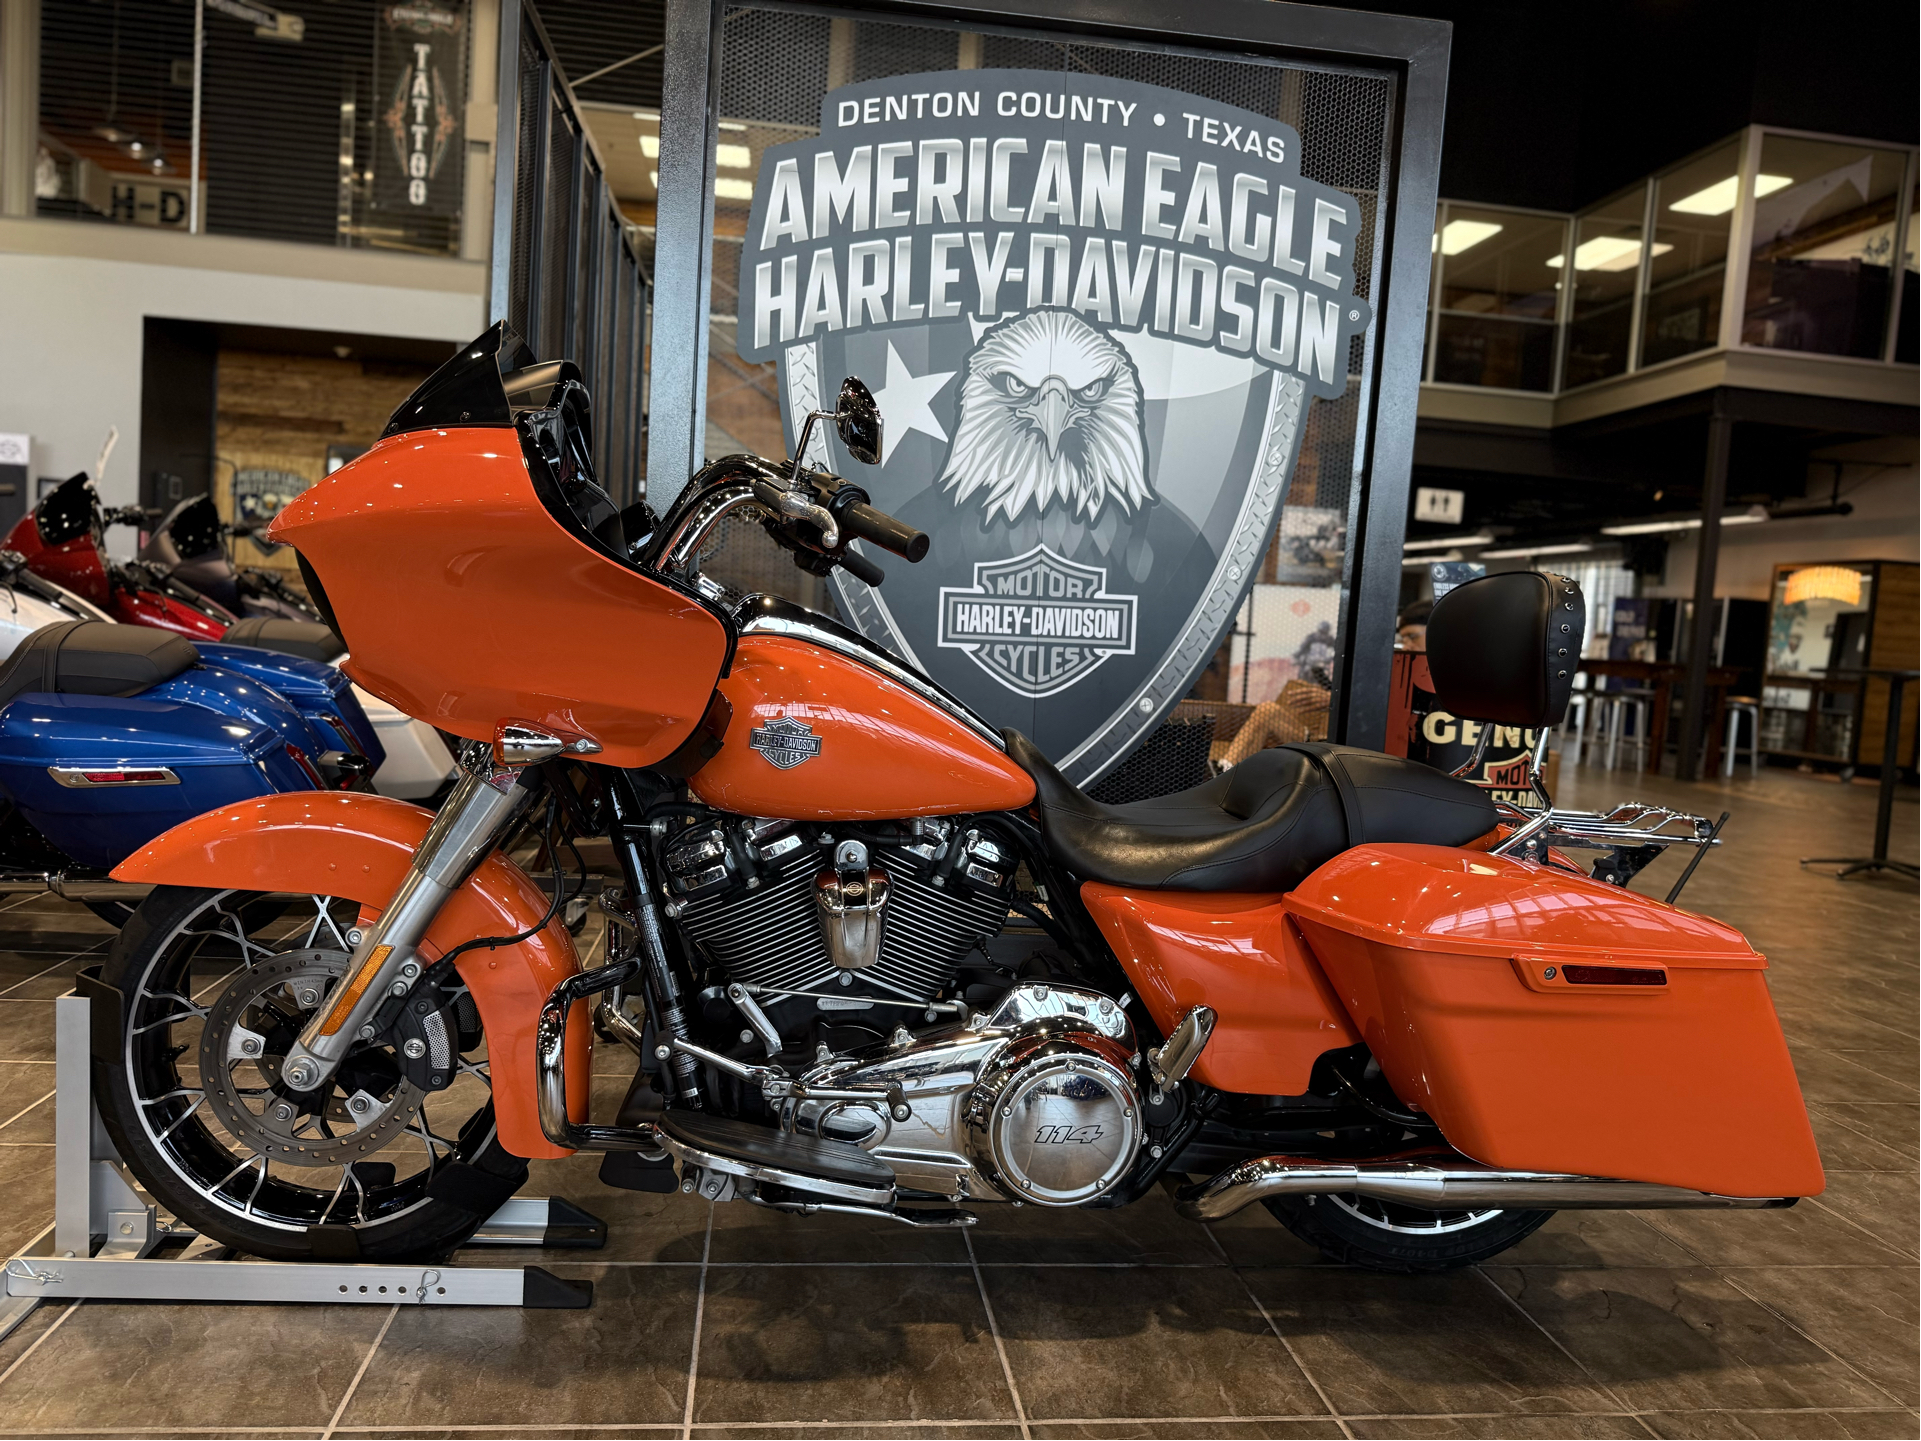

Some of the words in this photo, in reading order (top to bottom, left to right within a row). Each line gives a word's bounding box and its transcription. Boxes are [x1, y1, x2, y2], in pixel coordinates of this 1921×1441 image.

[408, 42, 431, 206] TATTOO
[837, 91, 979, 128] DENTON
[996, 90, 1138, 127] COUNTY
[1182, 112, 1286, 165] TEXAS
[112, 185, 185, 223] H-D
[759, 136, 1128, 252] AMERICAN
[1141, 150, 1348, 291] EAGLE
[753, 231, 1341, 386] HARLEY-DAVIDSON
[997, 563, 1083, 598] MOTOR
[956, 603, 1120, 638] HARLEY-DAVIDSON
[993, 644, 1080, 684] CYCLES
[756, 733, 817, 751] HARLEY-DAVIDSON
[769, 749, 801, 765] CYCLES
[1034, 1125, 1104, 1144] 114
